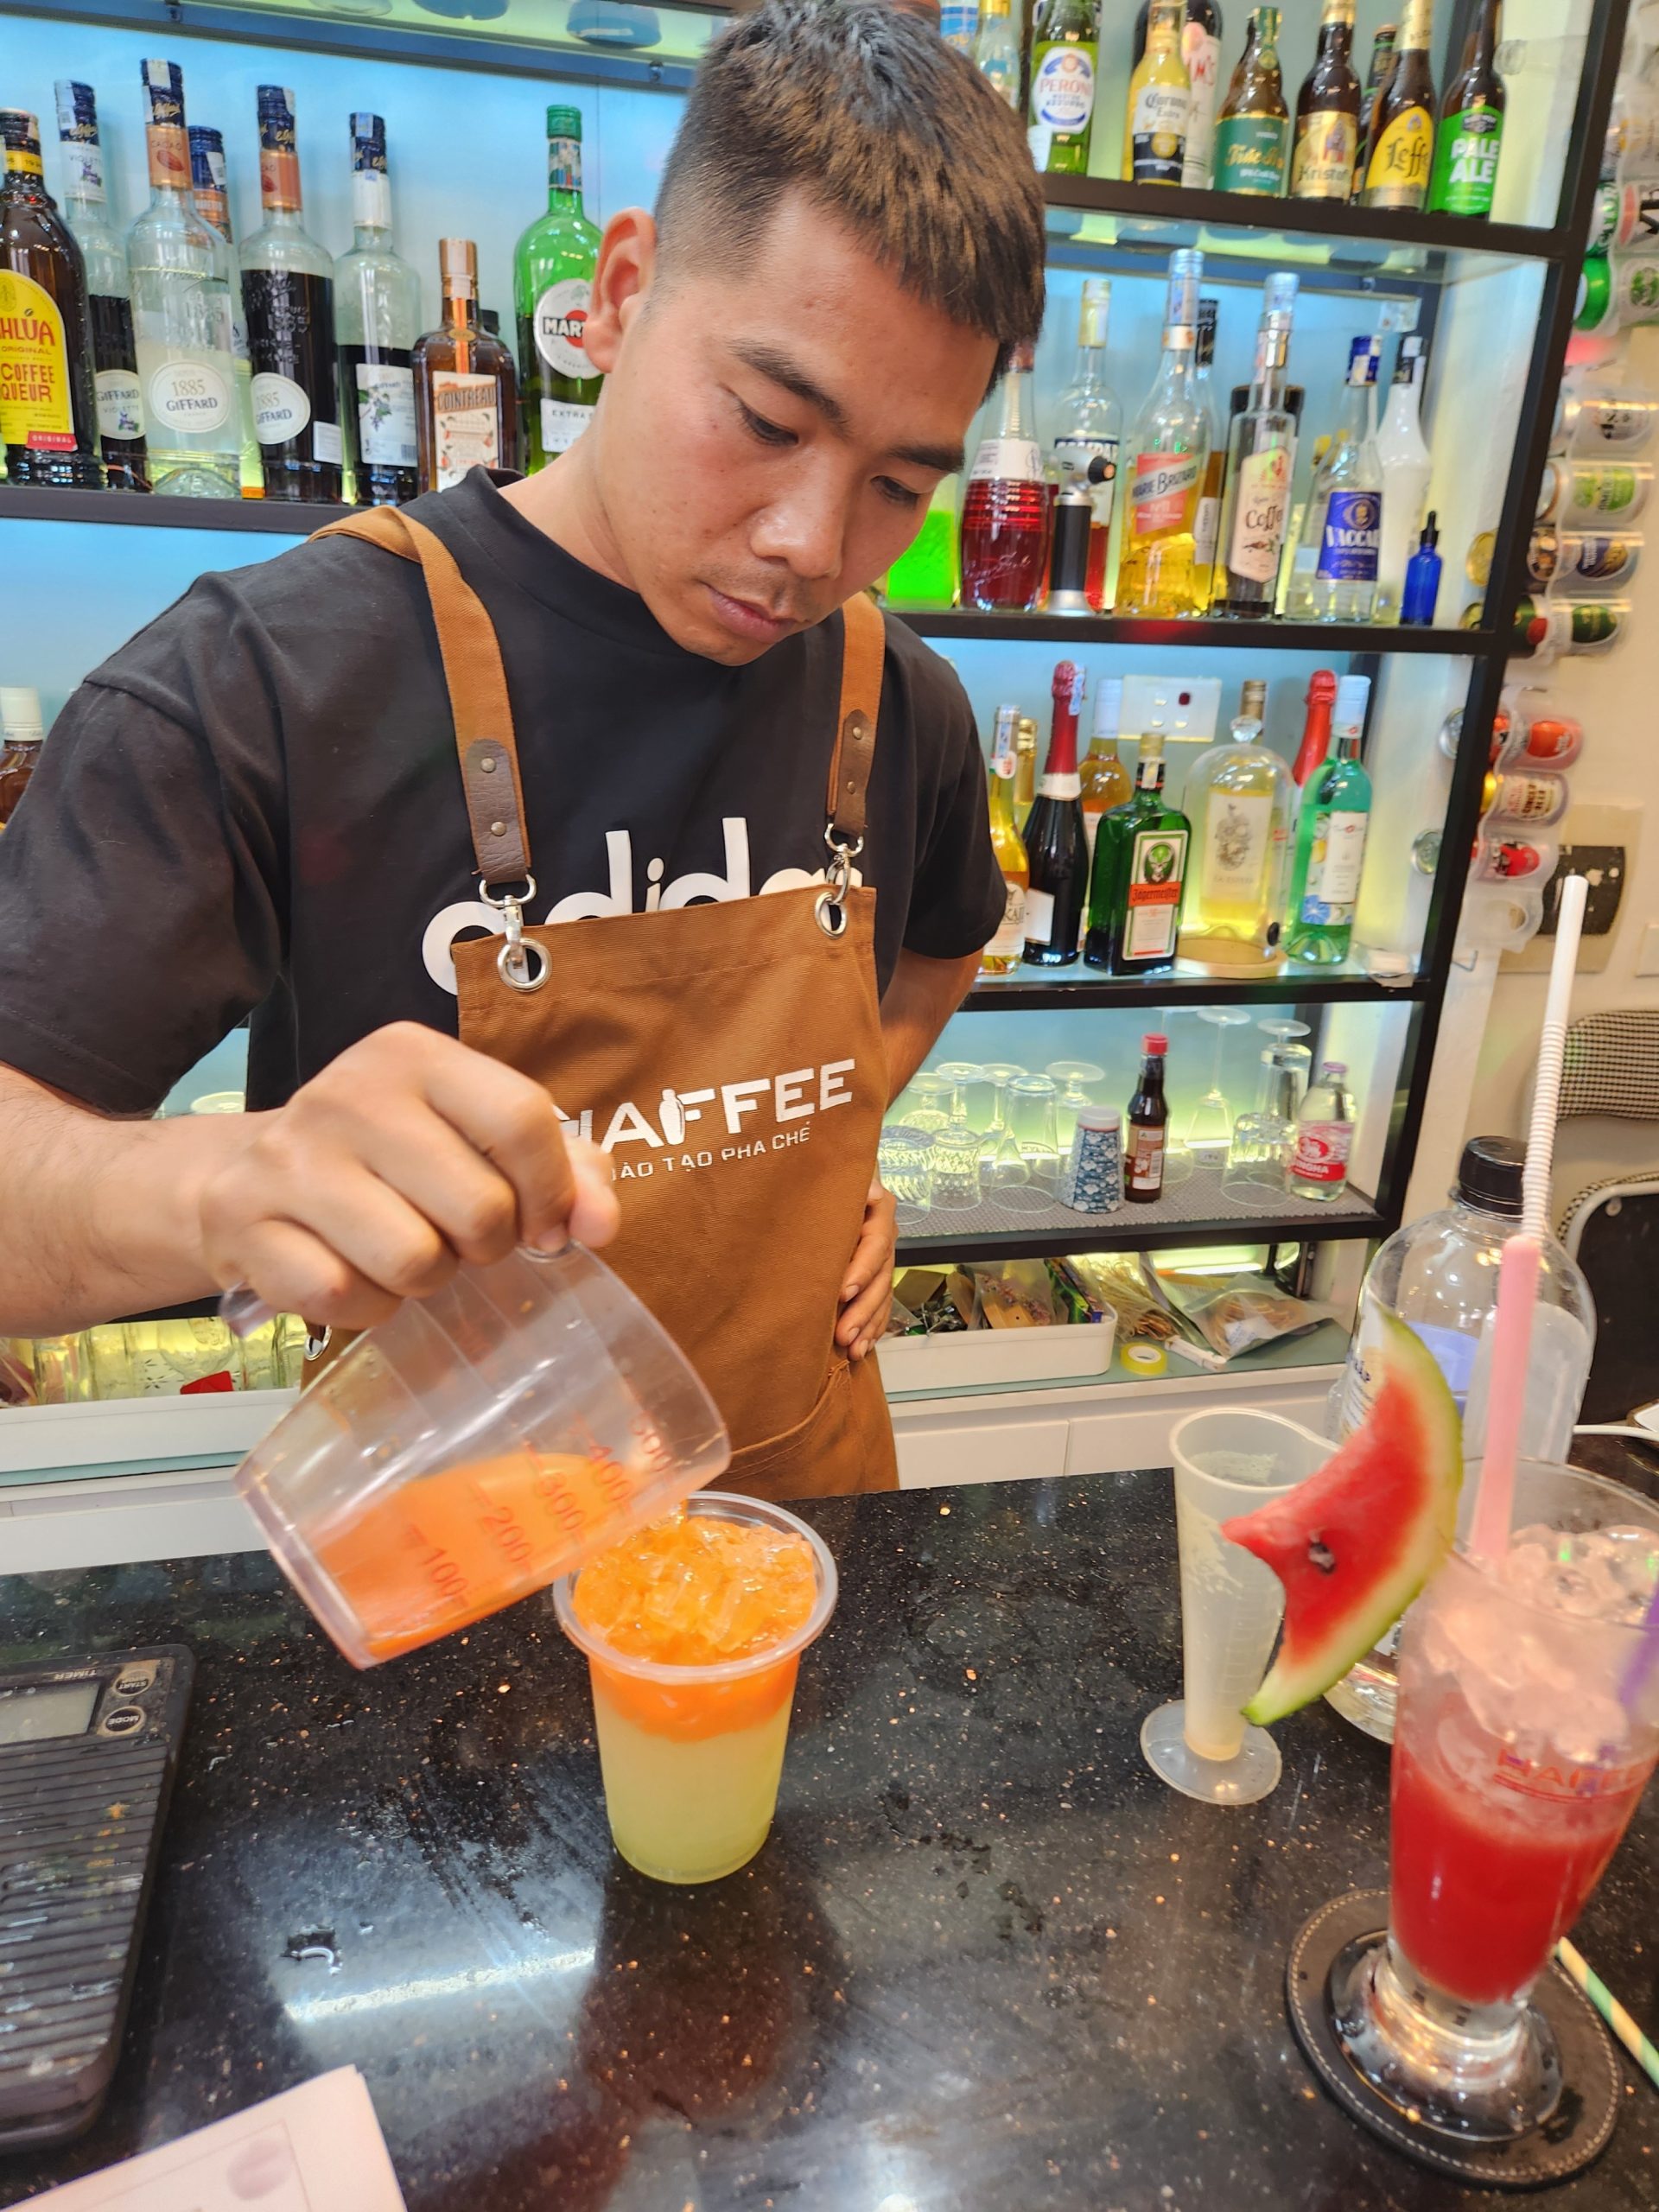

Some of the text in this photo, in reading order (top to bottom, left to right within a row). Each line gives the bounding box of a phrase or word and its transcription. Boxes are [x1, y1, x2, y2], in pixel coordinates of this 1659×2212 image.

[1451, 137, 1500, 160] PALE
[1449, 159, 1494, 183] ALE
[1, 362, 55, 384] COFFEE
[0, 383, 53, 404] QUEUR
[172, 378, 206, 397] 1885
[166, 397, 218, 411] GIFFARD
[721, 1140, 766, 1160] PHA
[588, 1445, 634, 1504] 400
[536, 1471, 586, 1533] 300
[480, 1506, 533, 1564] 200
[420, 1547, 470, 1599] 100
[54, 1669, 98, 1681] TIMER
[107, 1714, 140, 1726] MODE
